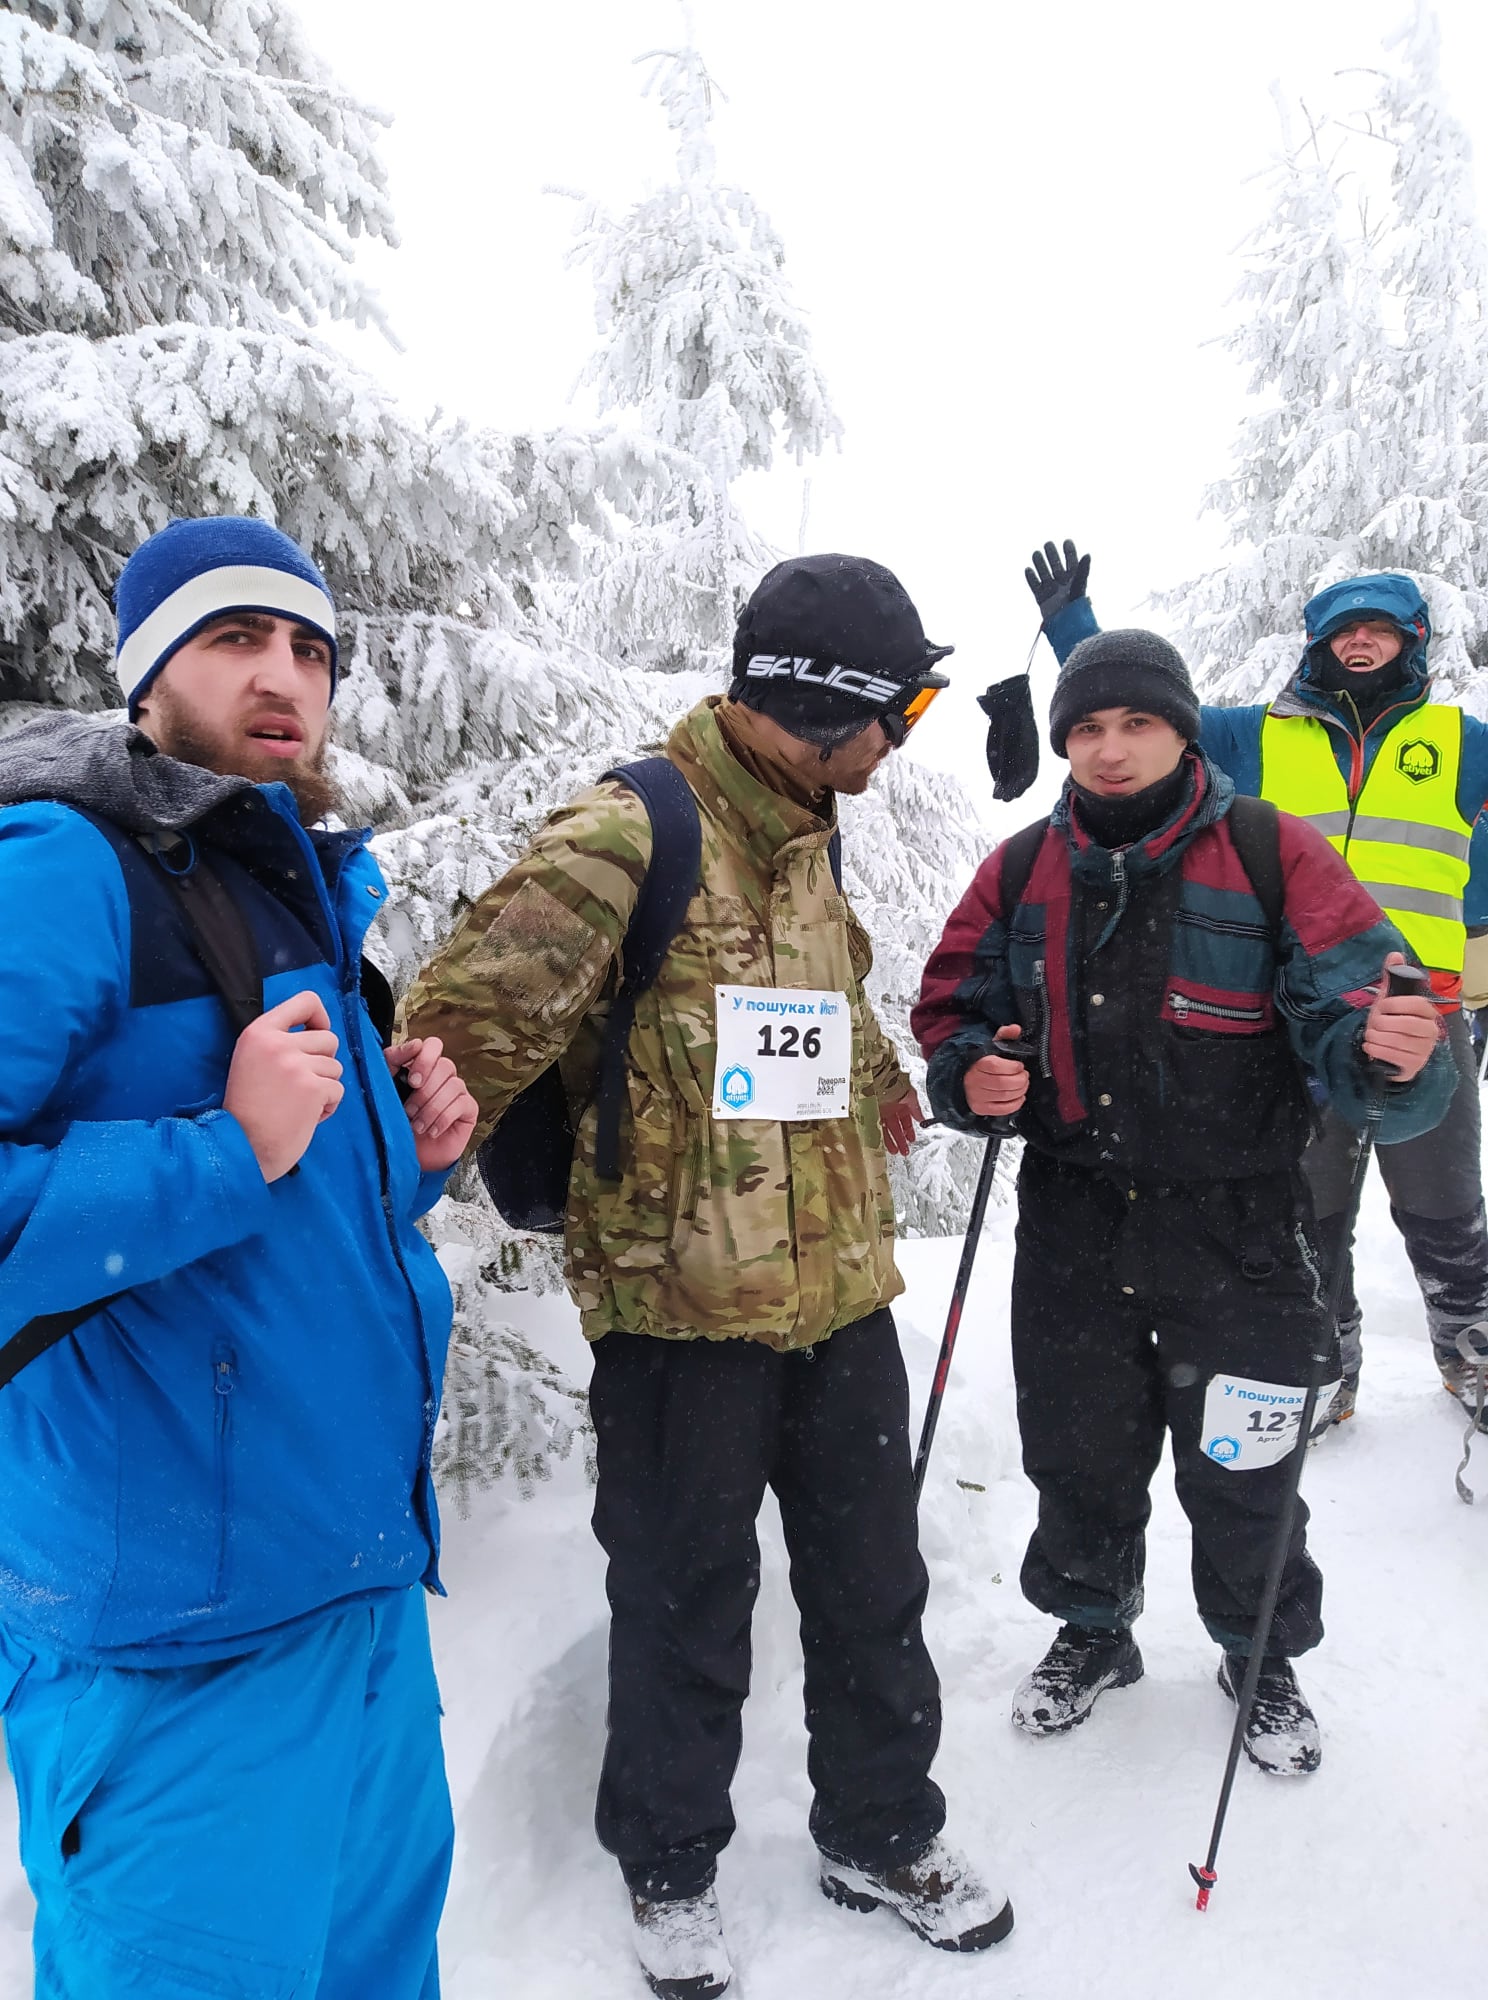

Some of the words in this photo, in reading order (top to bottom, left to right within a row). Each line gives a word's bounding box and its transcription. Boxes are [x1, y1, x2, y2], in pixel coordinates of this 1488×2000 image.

[746, 655, 903, 702] SALICE
[1402, 765, 1433, 776] etiyeti
[732, 997, 743, 1010] У
[746, 1000, 815, 1016] пошуках
[757, 1025, 821, 1059] 126
[1224, 1384, 1235, 1396] У
[1237, 1390, 1303, 1406] пошуках
